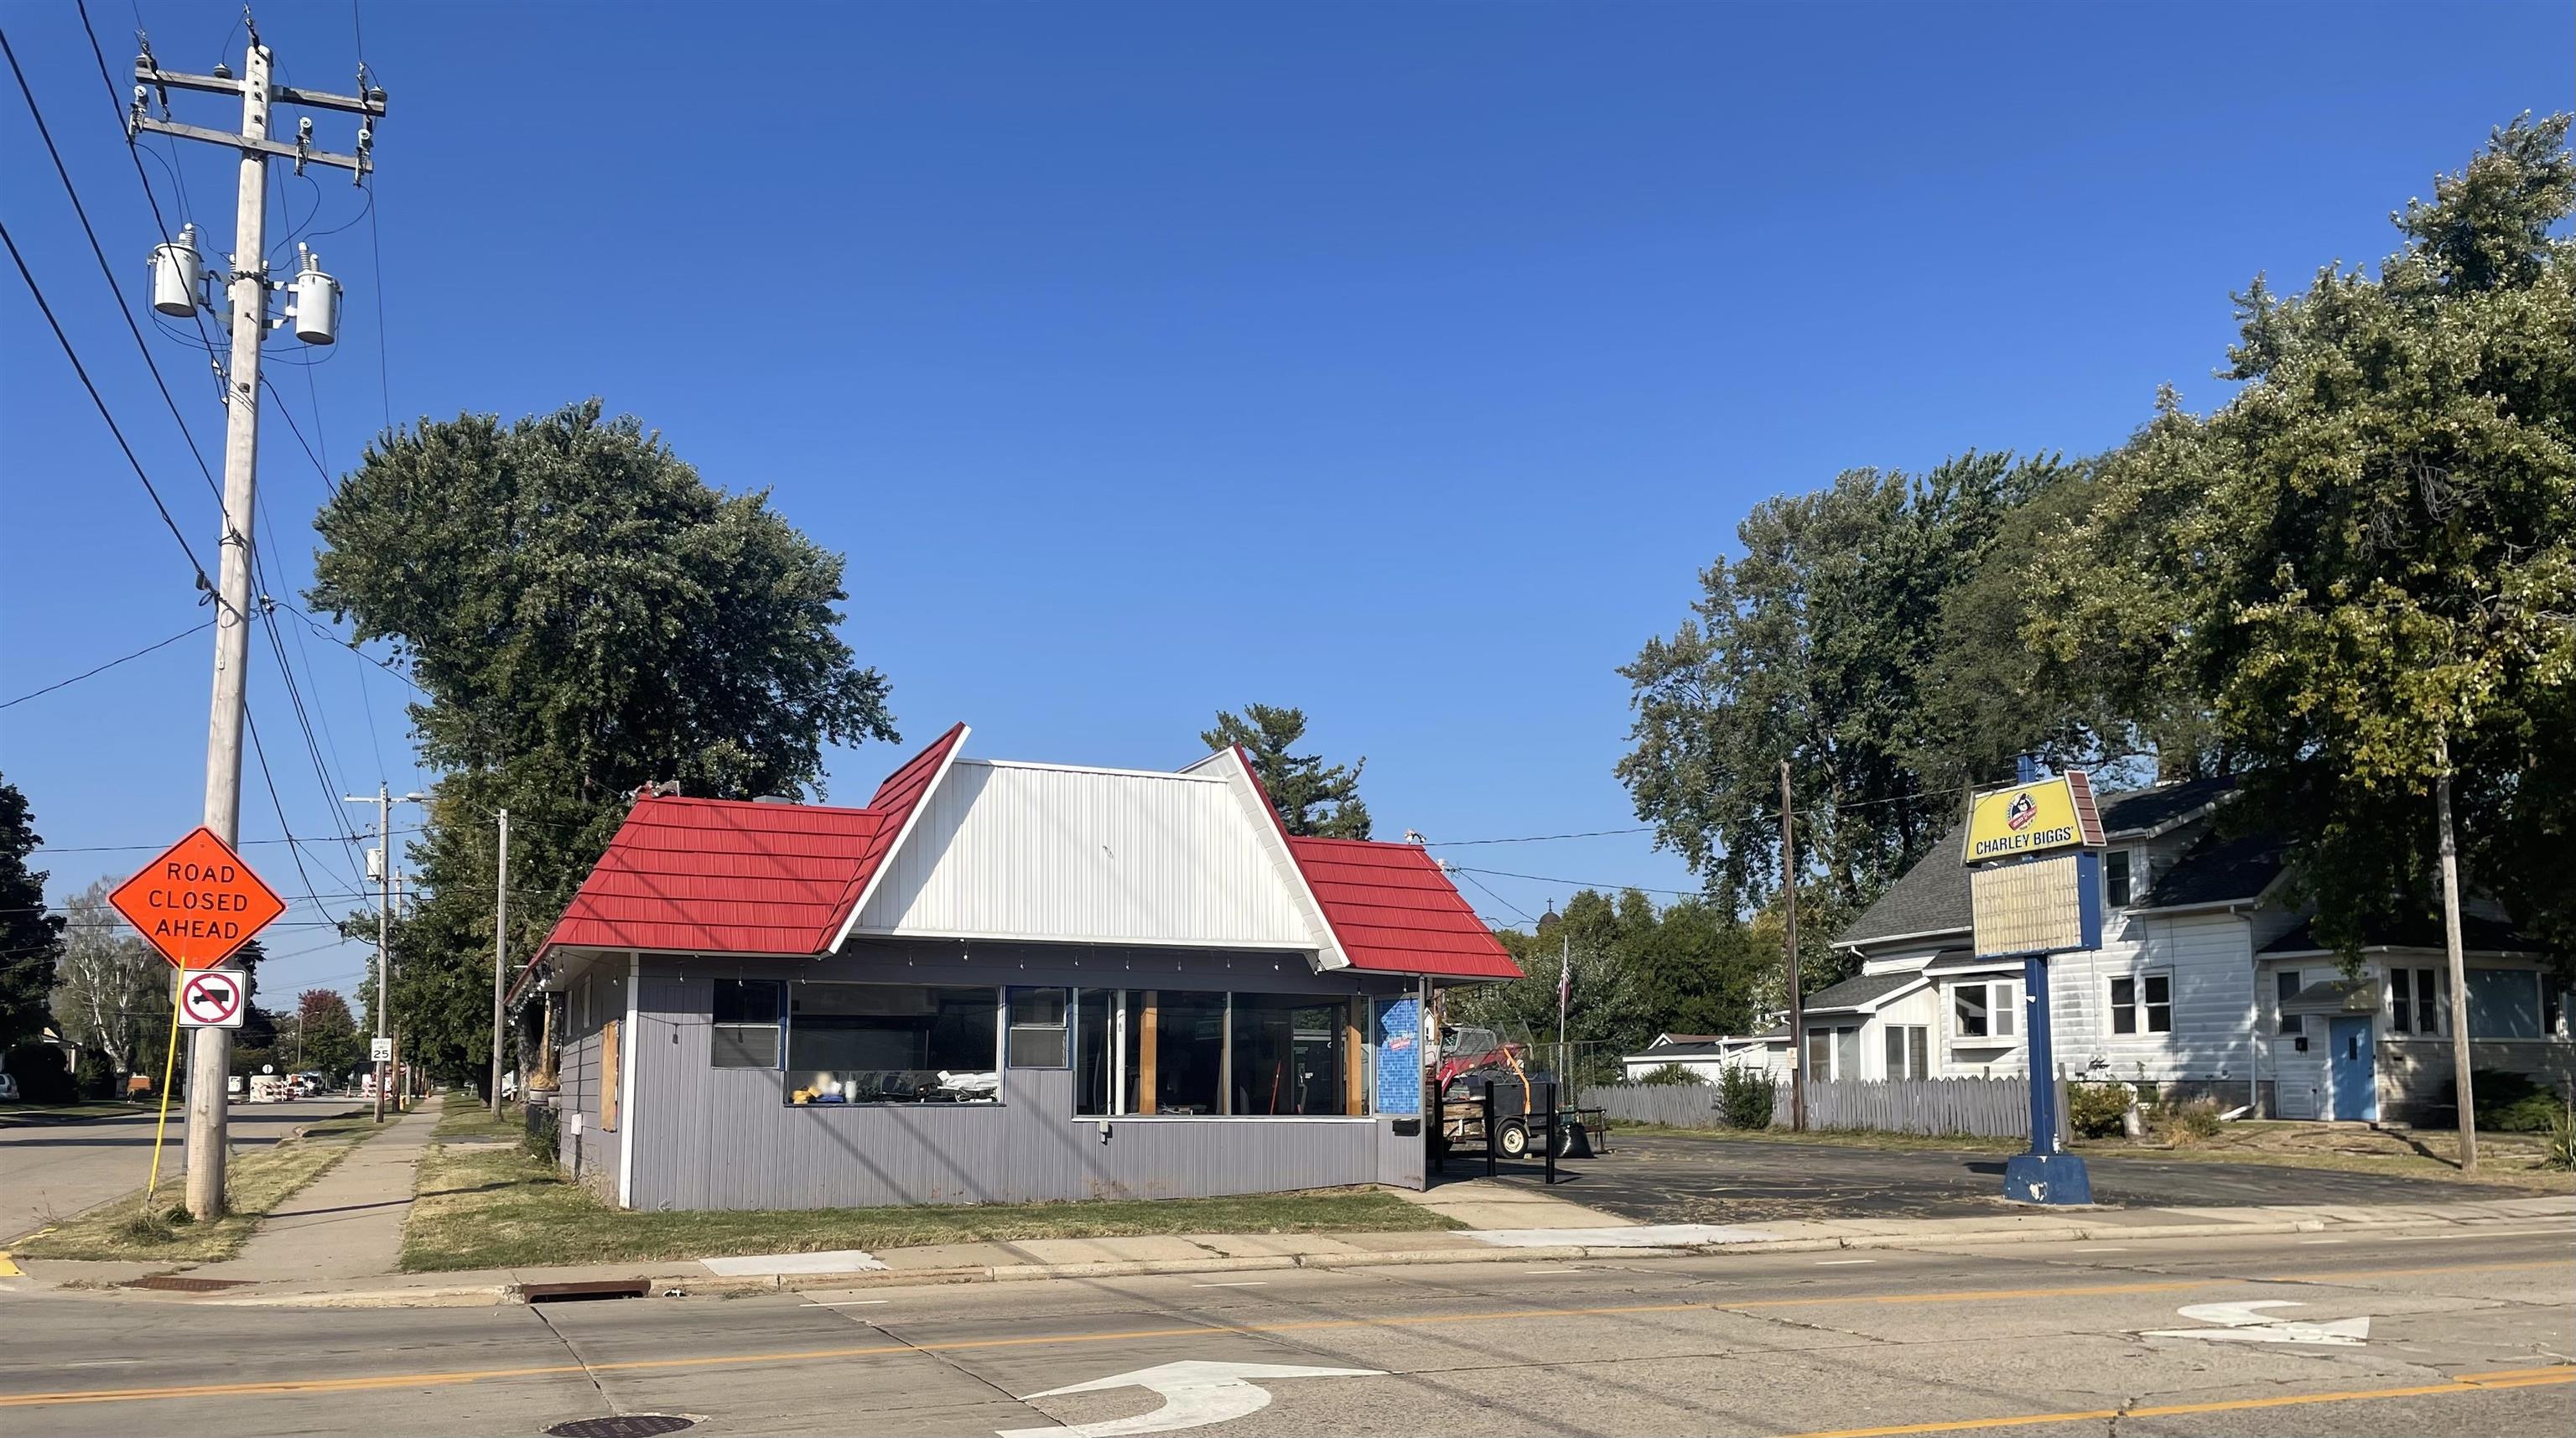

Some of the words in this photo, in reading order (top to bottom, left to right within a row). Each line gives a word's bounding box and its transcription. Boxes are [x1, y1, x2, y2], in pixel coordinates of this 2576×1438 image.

[1976, 833, 2029, 854] CHARLEY
[168, 863, 235, 883] ROAD
[149, 890, 247, 911] CLOSED
[155, 919, 238, 939] AHEAD
[374, 1050, 389, 1058] 25
